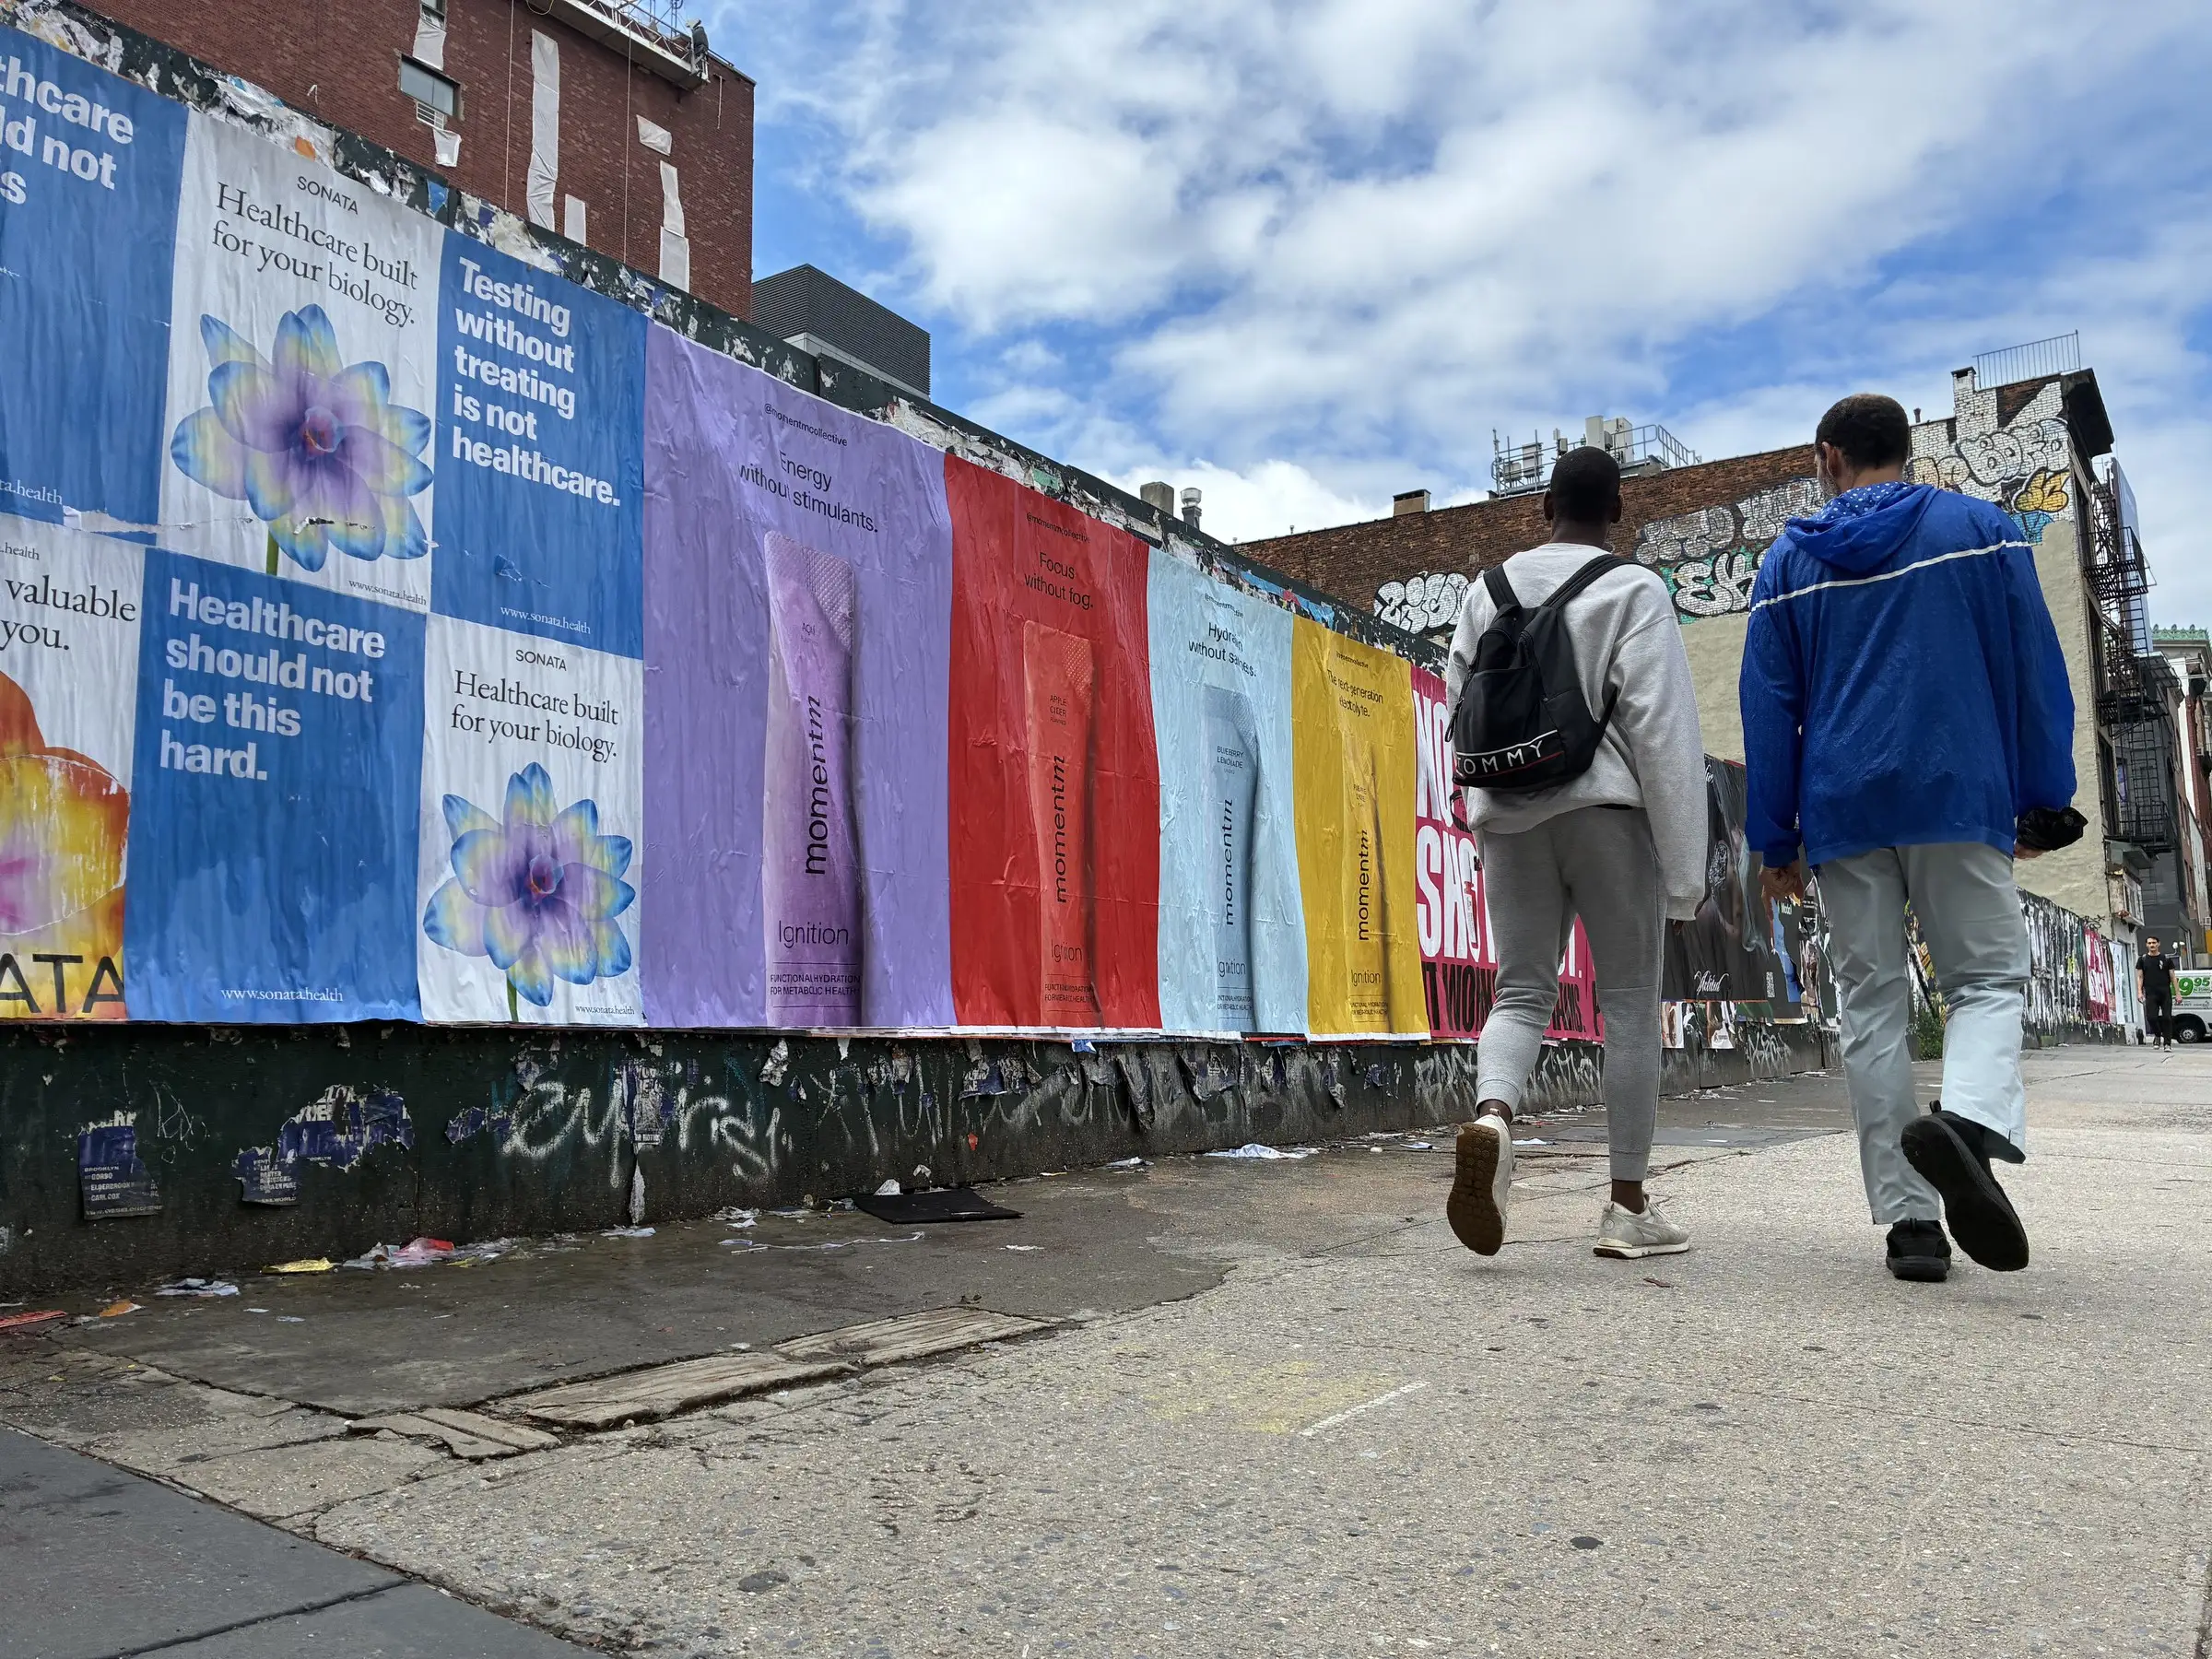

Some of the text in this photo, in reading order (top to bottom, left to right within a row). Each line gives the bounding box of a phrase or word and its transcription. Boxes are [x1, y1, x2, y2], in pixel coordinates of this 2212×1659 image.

[42, 135, 117, 191] not
[298, 176, 359, 215] SONATA
[217, 182, 418, 291] Healthcare built
[212, 220, 415, 327] for your biology.
[458, 257, 571, 337] Testing
[454, 307, 575, 372] without
[454, 345, 575, 419] treating
[453, 384, 537, 441] is not
[453, 427, 621, 507] healthcare.
[780, 451, 832, 492] Energy
[738, 462, 878, 533] without stimulants.
[1040, 552, 1075, 580] Focus
[5, 575, 136, 621] valuable
[348, 578, 427, 606] www.sonata.health
[1024, 573, 1093, 610] without fog.
[0, 620, 69, 651] you.
[170, 578, 385, 658] Healthcare
[500, 606, 591, 634] www.sonata.health
[166, 634, 373, 703] should not
[515, 649, 567, 671] SONATA
[1189, 641, 1227, 661] wthout
[163, 679, 302, 736] be this
[454, 669, 619, 725] Healthcare built
[160, 729, 268, 781] hard.
[451, 704, 618, 763] for your biology.
[1456, 740, 1543, 775] TOMMY
[779, 921, 849, 948] Ignition
[220, 986, 343, 1003] www.sonata.health
[770, 973, 860, 983] FUNCTIONAL HYDRATION
[770, 986, 782, 995] FOR
[575, 1005, 635, 1016] www.sonata.health
